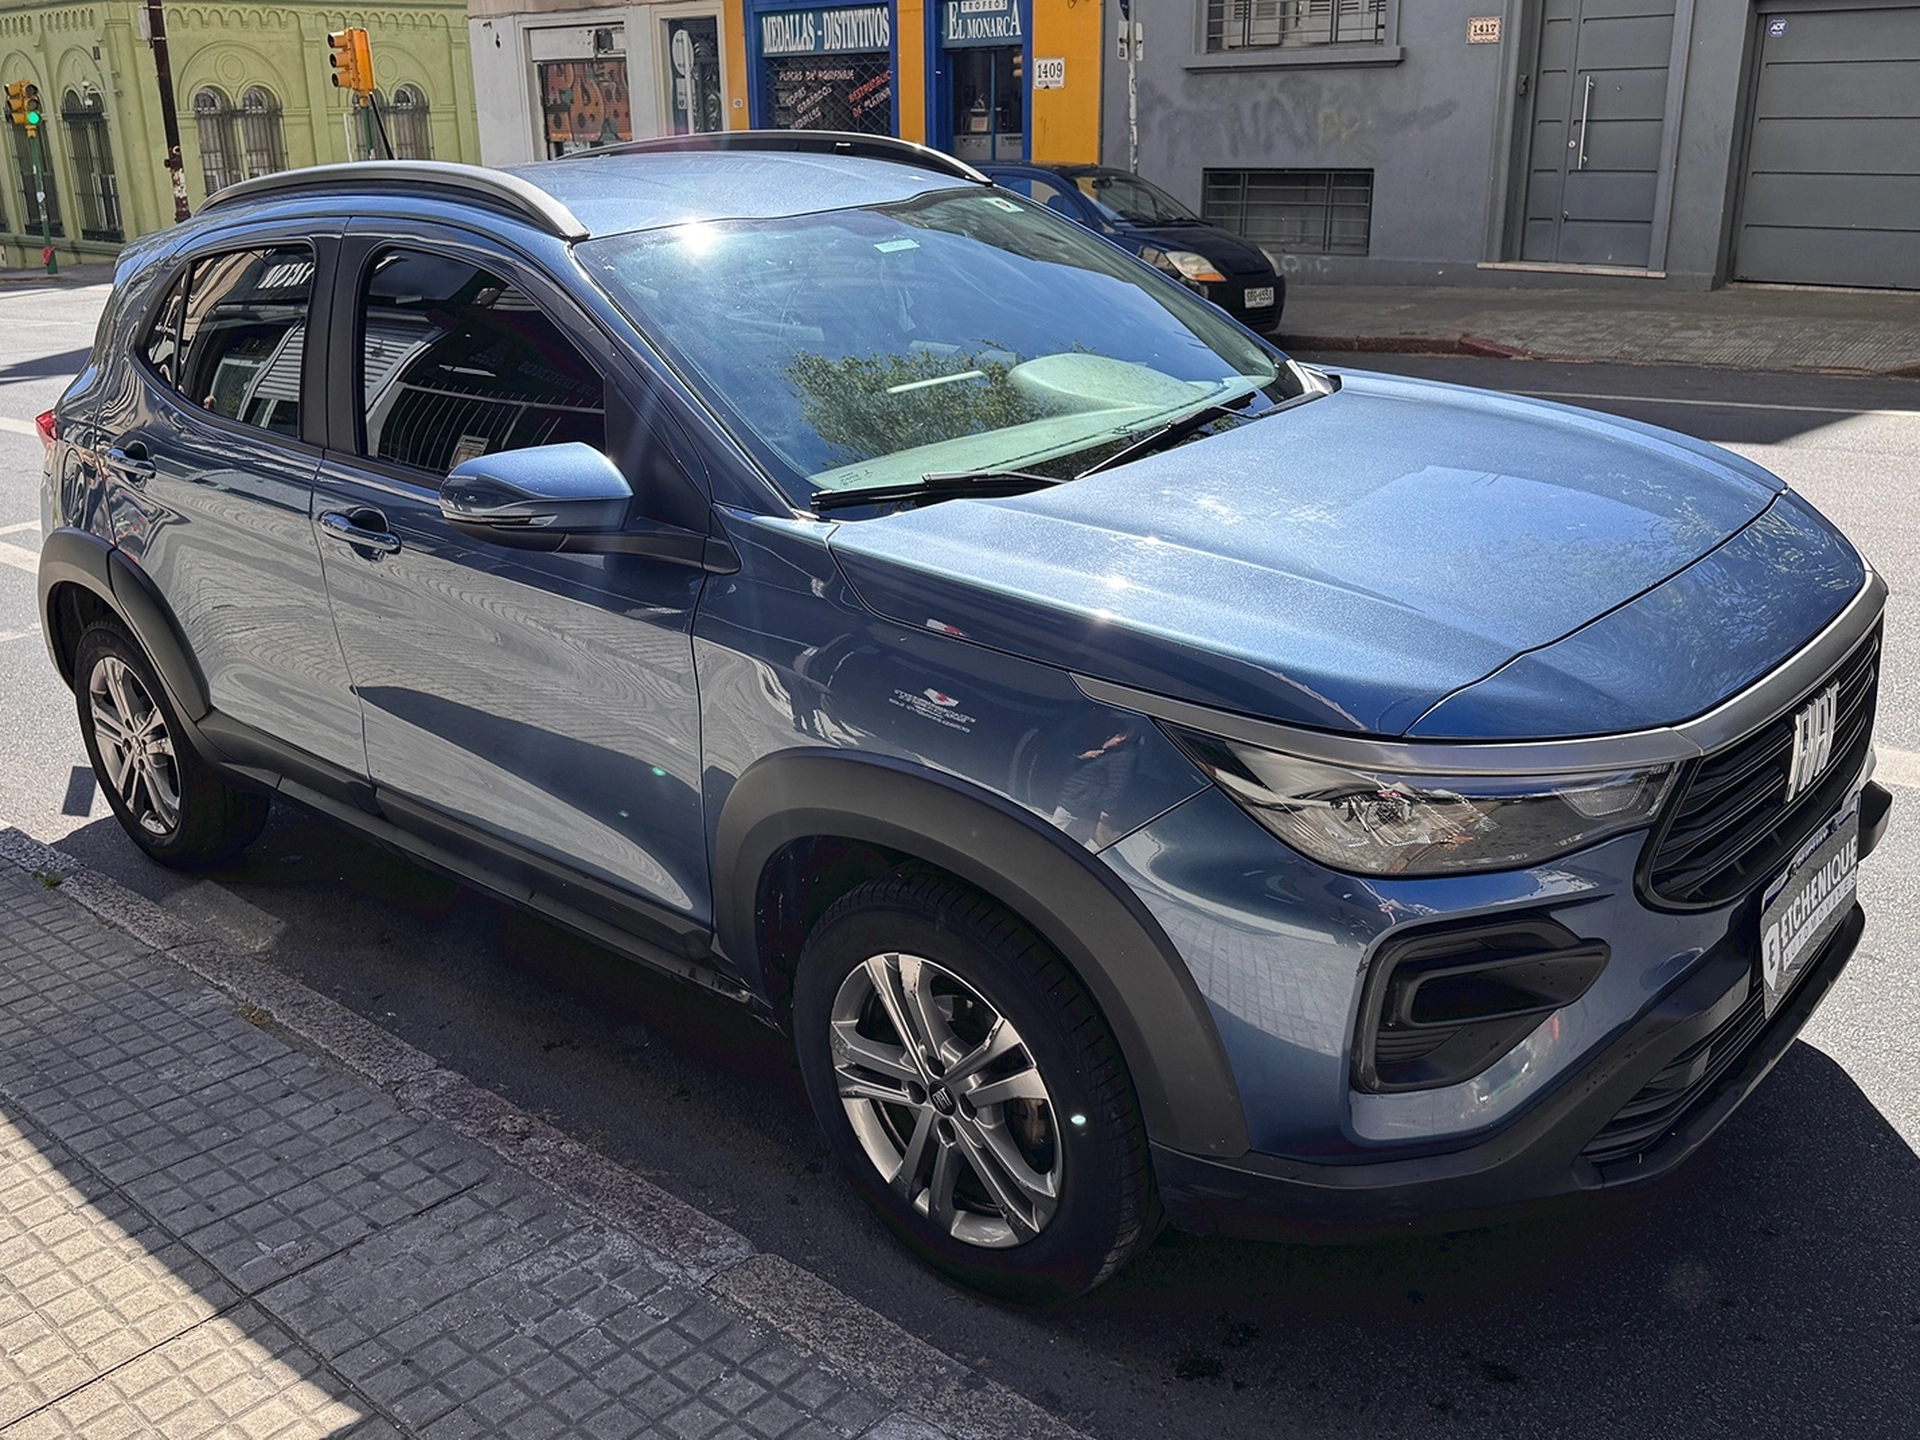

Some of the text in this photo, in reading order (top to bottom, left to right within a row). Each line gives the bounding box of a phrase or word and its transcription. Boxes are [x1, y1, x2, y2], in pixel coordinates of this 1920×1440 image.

[962, 0, 1007, 11] TROFEOS
[967, 0, 1022, 39] MONARCA
[762, 13, 815, 53] MEDALLAS
[822, 7, 890, 50] DISTINTIVOS
[1473, 23, 1497, 33] 1417
[1037, 62, 1063, 79] 1409
[1786, 678, 1841, 804] FIAT
[1779, 835, 1858, 944] ETCHENIQUE
[1784, 872, 1857, 966] AUTOMOVILES
